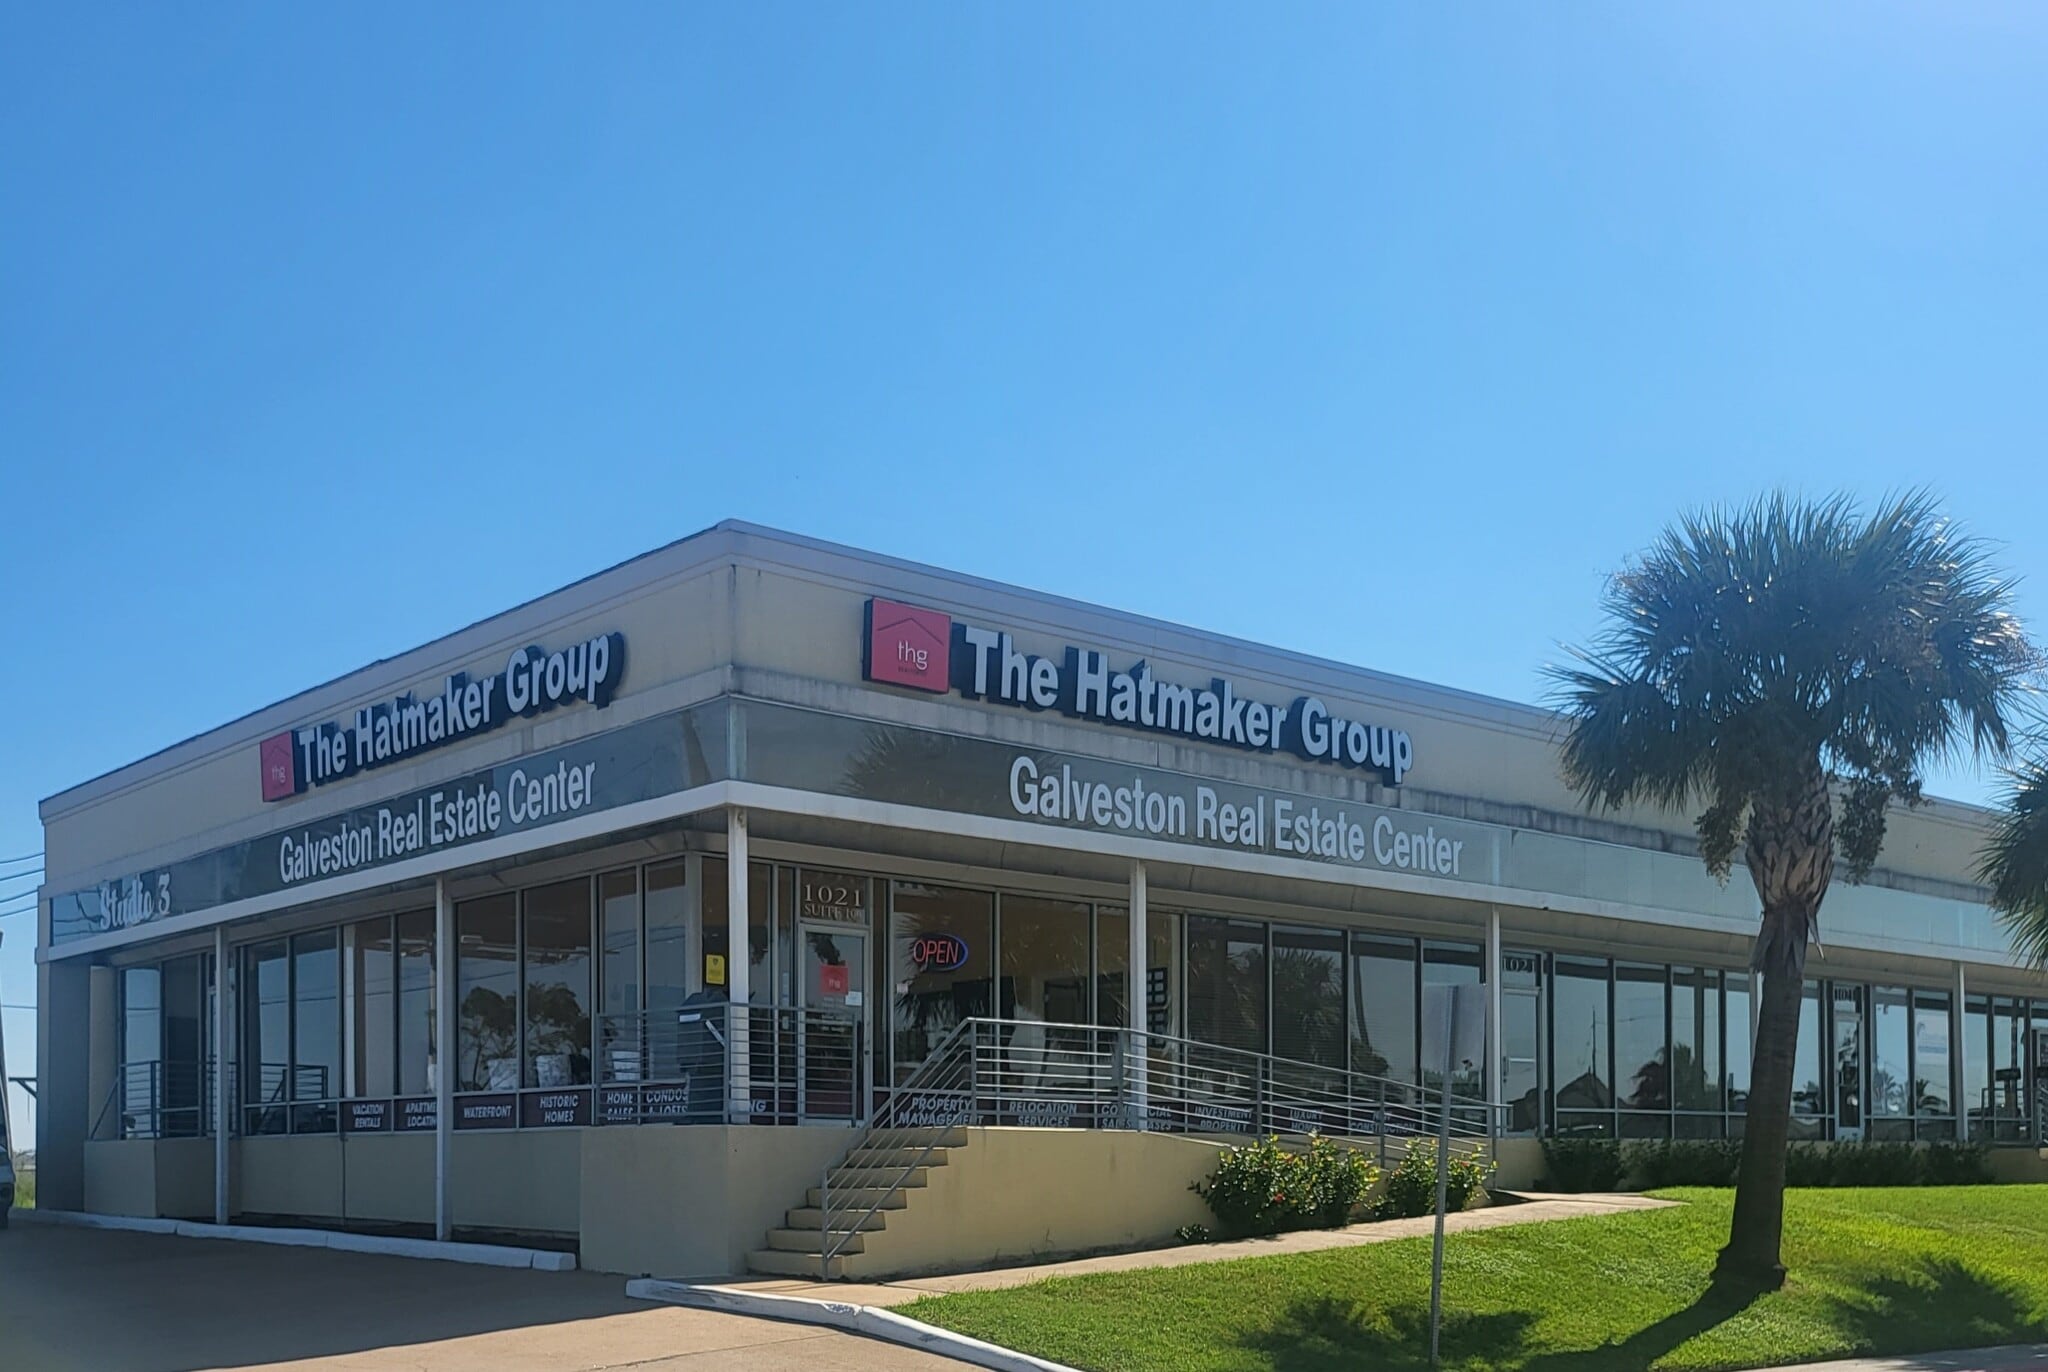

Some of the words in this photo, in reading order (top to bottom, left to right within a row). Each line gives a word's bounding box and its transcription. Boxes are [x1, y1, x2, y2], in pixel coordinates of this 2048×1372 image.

[898, 640, 928, 671] thg
[299, 723, 347, 783] The
[355, 676, 496, 766] Hatmaker
[506, 633, 610, 713] Group
[965, 624, 1059, 709] The
[1075, 648, 1288, 750] Hatmaker
[1301, 697, 1414, 784] Group
[280, 818, 372, 884] Galveston
[378, 797, 424, 859] Real
[430, 783, 501, 846] Estate
[508, 759, 597, 825] Center
[1010, 755, 1186, 837] Galveston
[1196, 786, 1264, 847] Real
[1274, 798, 1365, 862] Estate
[1373, 815, 1464, 876] Center
[100, 873, 154, 930] Studio
[158, 872, 171, 916] 3
[804, 884, 862, 907] 1021
[804, 903, 842, 920] SUITE
[913, 940, 959, 964] OPEN
[1503, 958, 1535, 973] 1021
[539, 1095, 579, 1109] HISTORIC
[607, 1091, 633, 1104] HOME
[912, 1097, 971, 1111] PROPERTY
[353, 1103, 385, 1115] VACATION
[463, 1106, 513, 1119] WATERFRONT
[1009, 1101, 1078, 1114] RELOCATION
[1195, 1106, 1253, 1119] INVESTMENT
[354, 1117, 382, 1129] RENTALS
[544, 1110, 574, 1123] HOMES
[1017, 1115, 1070, 1127] SERVICES
